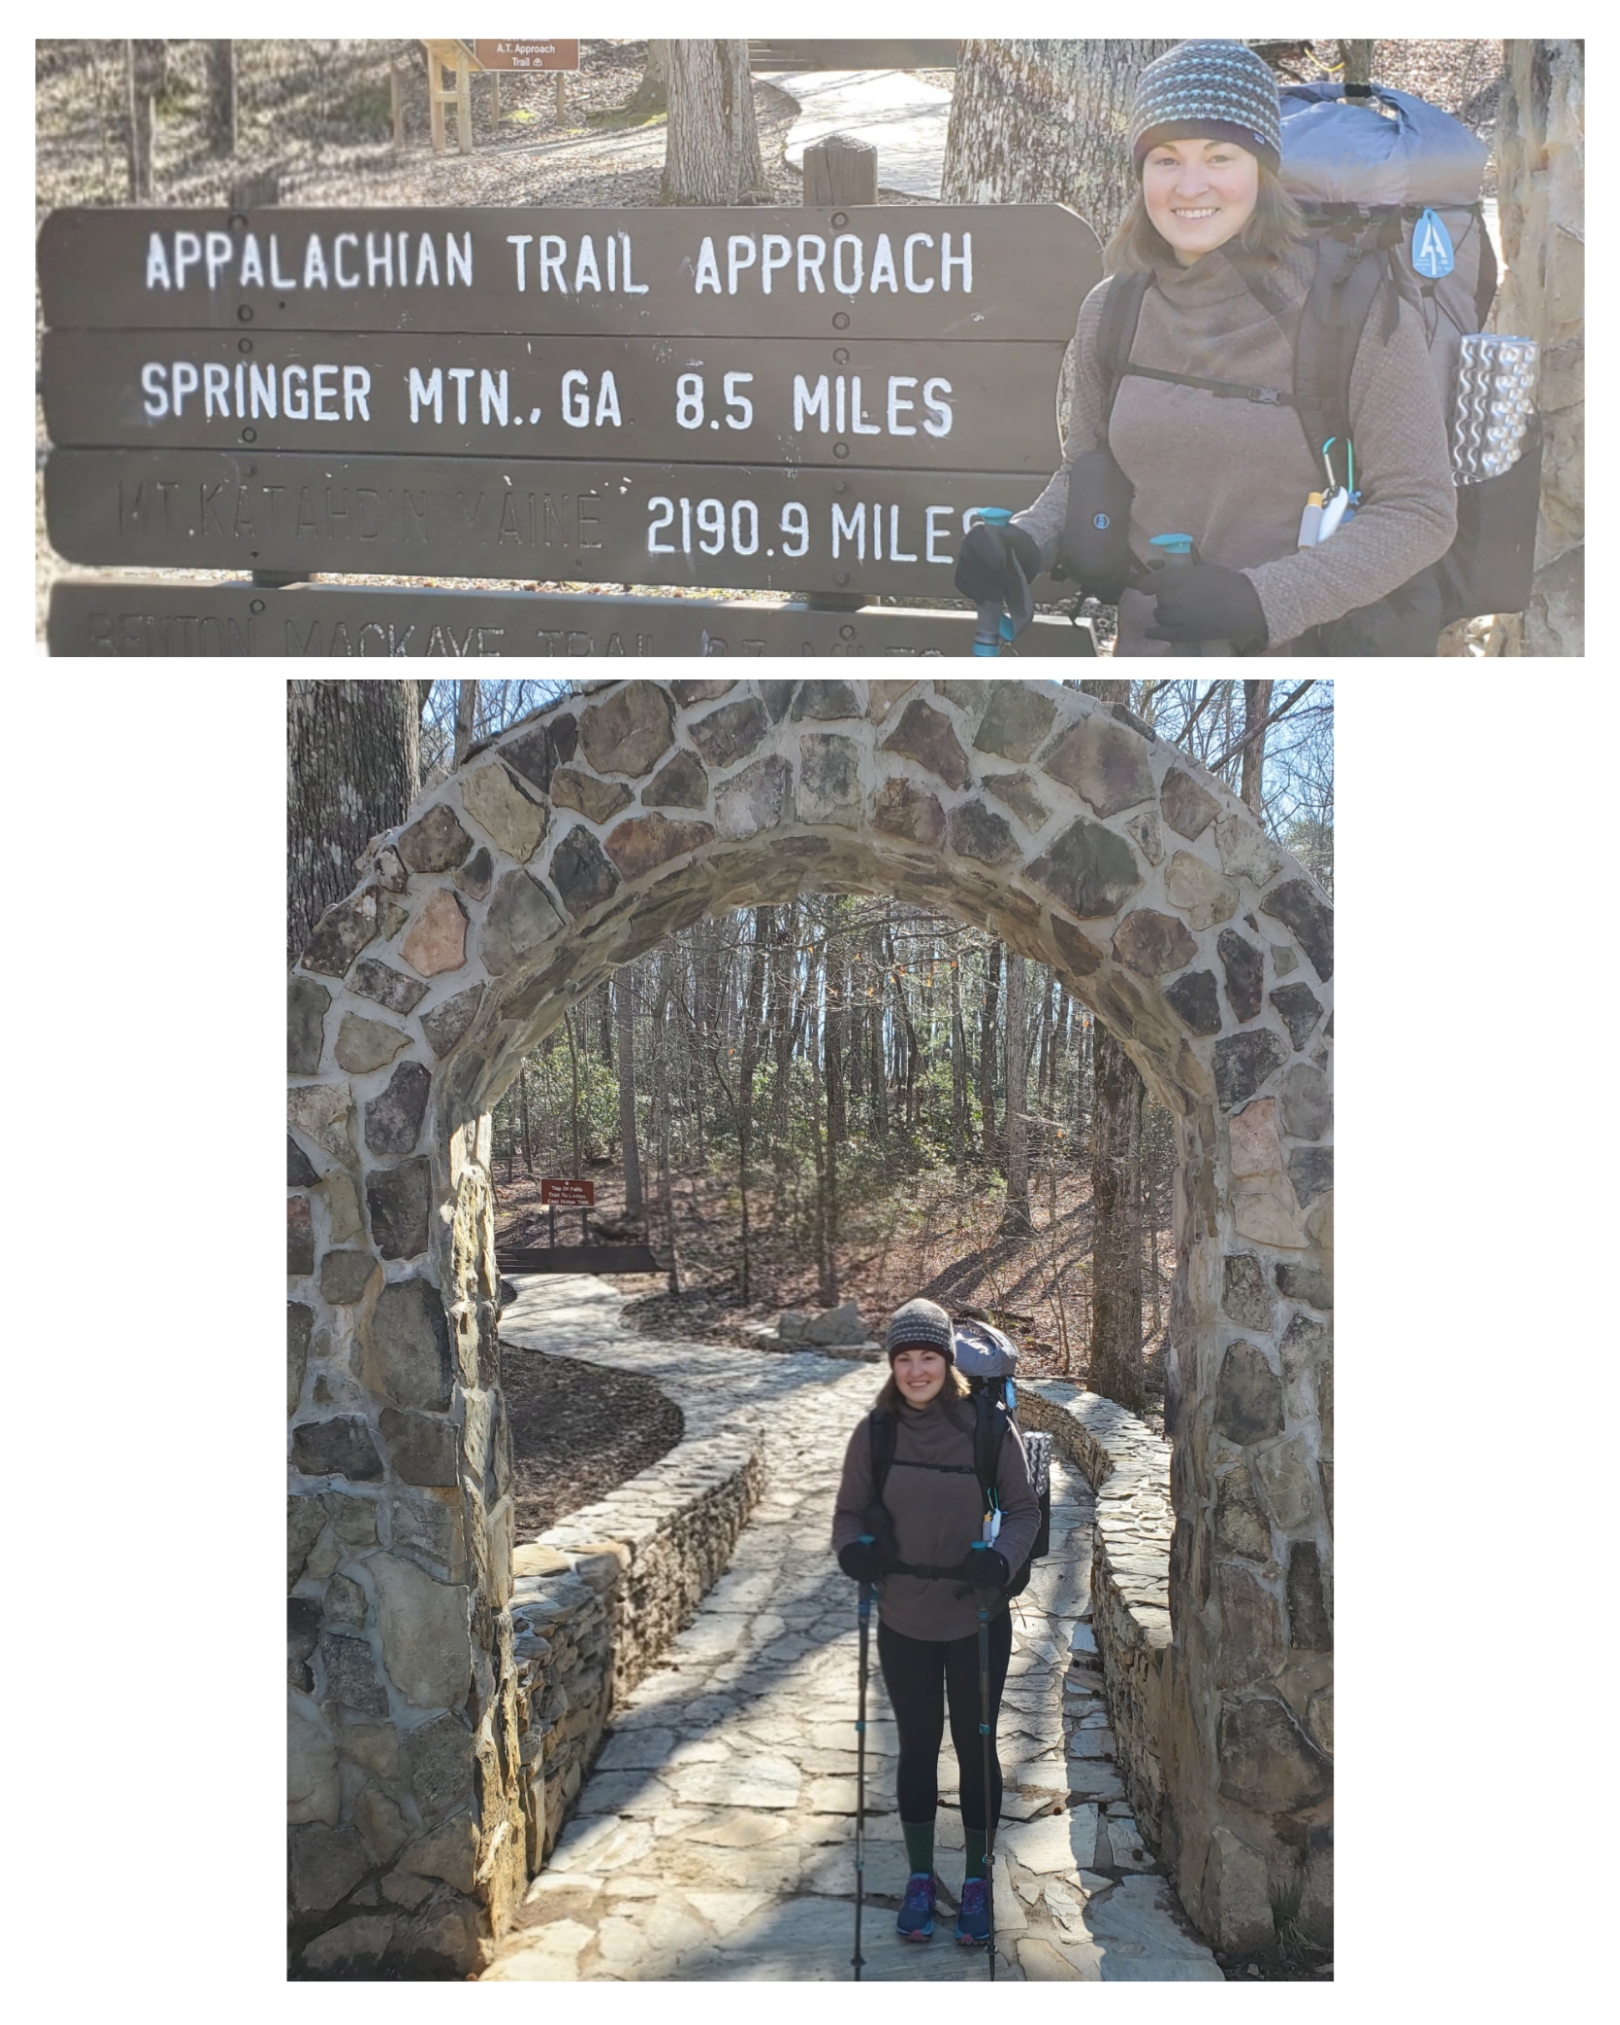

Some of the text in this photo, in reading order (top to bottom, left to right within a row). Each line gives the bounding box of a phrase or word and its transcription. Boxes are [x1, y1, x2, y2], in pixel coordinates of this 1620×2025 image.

[497, 43, 555, 55] A.T. Approach
[511, 57, 530, 67] Trail
[146, 231, 973, 295] APPALACHIAN TRAIL APPROACH
[142, 362, 371, 422] SPRINGER
[561, 369, 623, 428] GA
[676, 372, 753, 430] 8.5
[793, 375, 953, 438] MILES
[201, 483, 429, 543] KATAHDIN
[456, 490, 602, 548] MAINE
[647, 496, 809, 558] 2190.9
